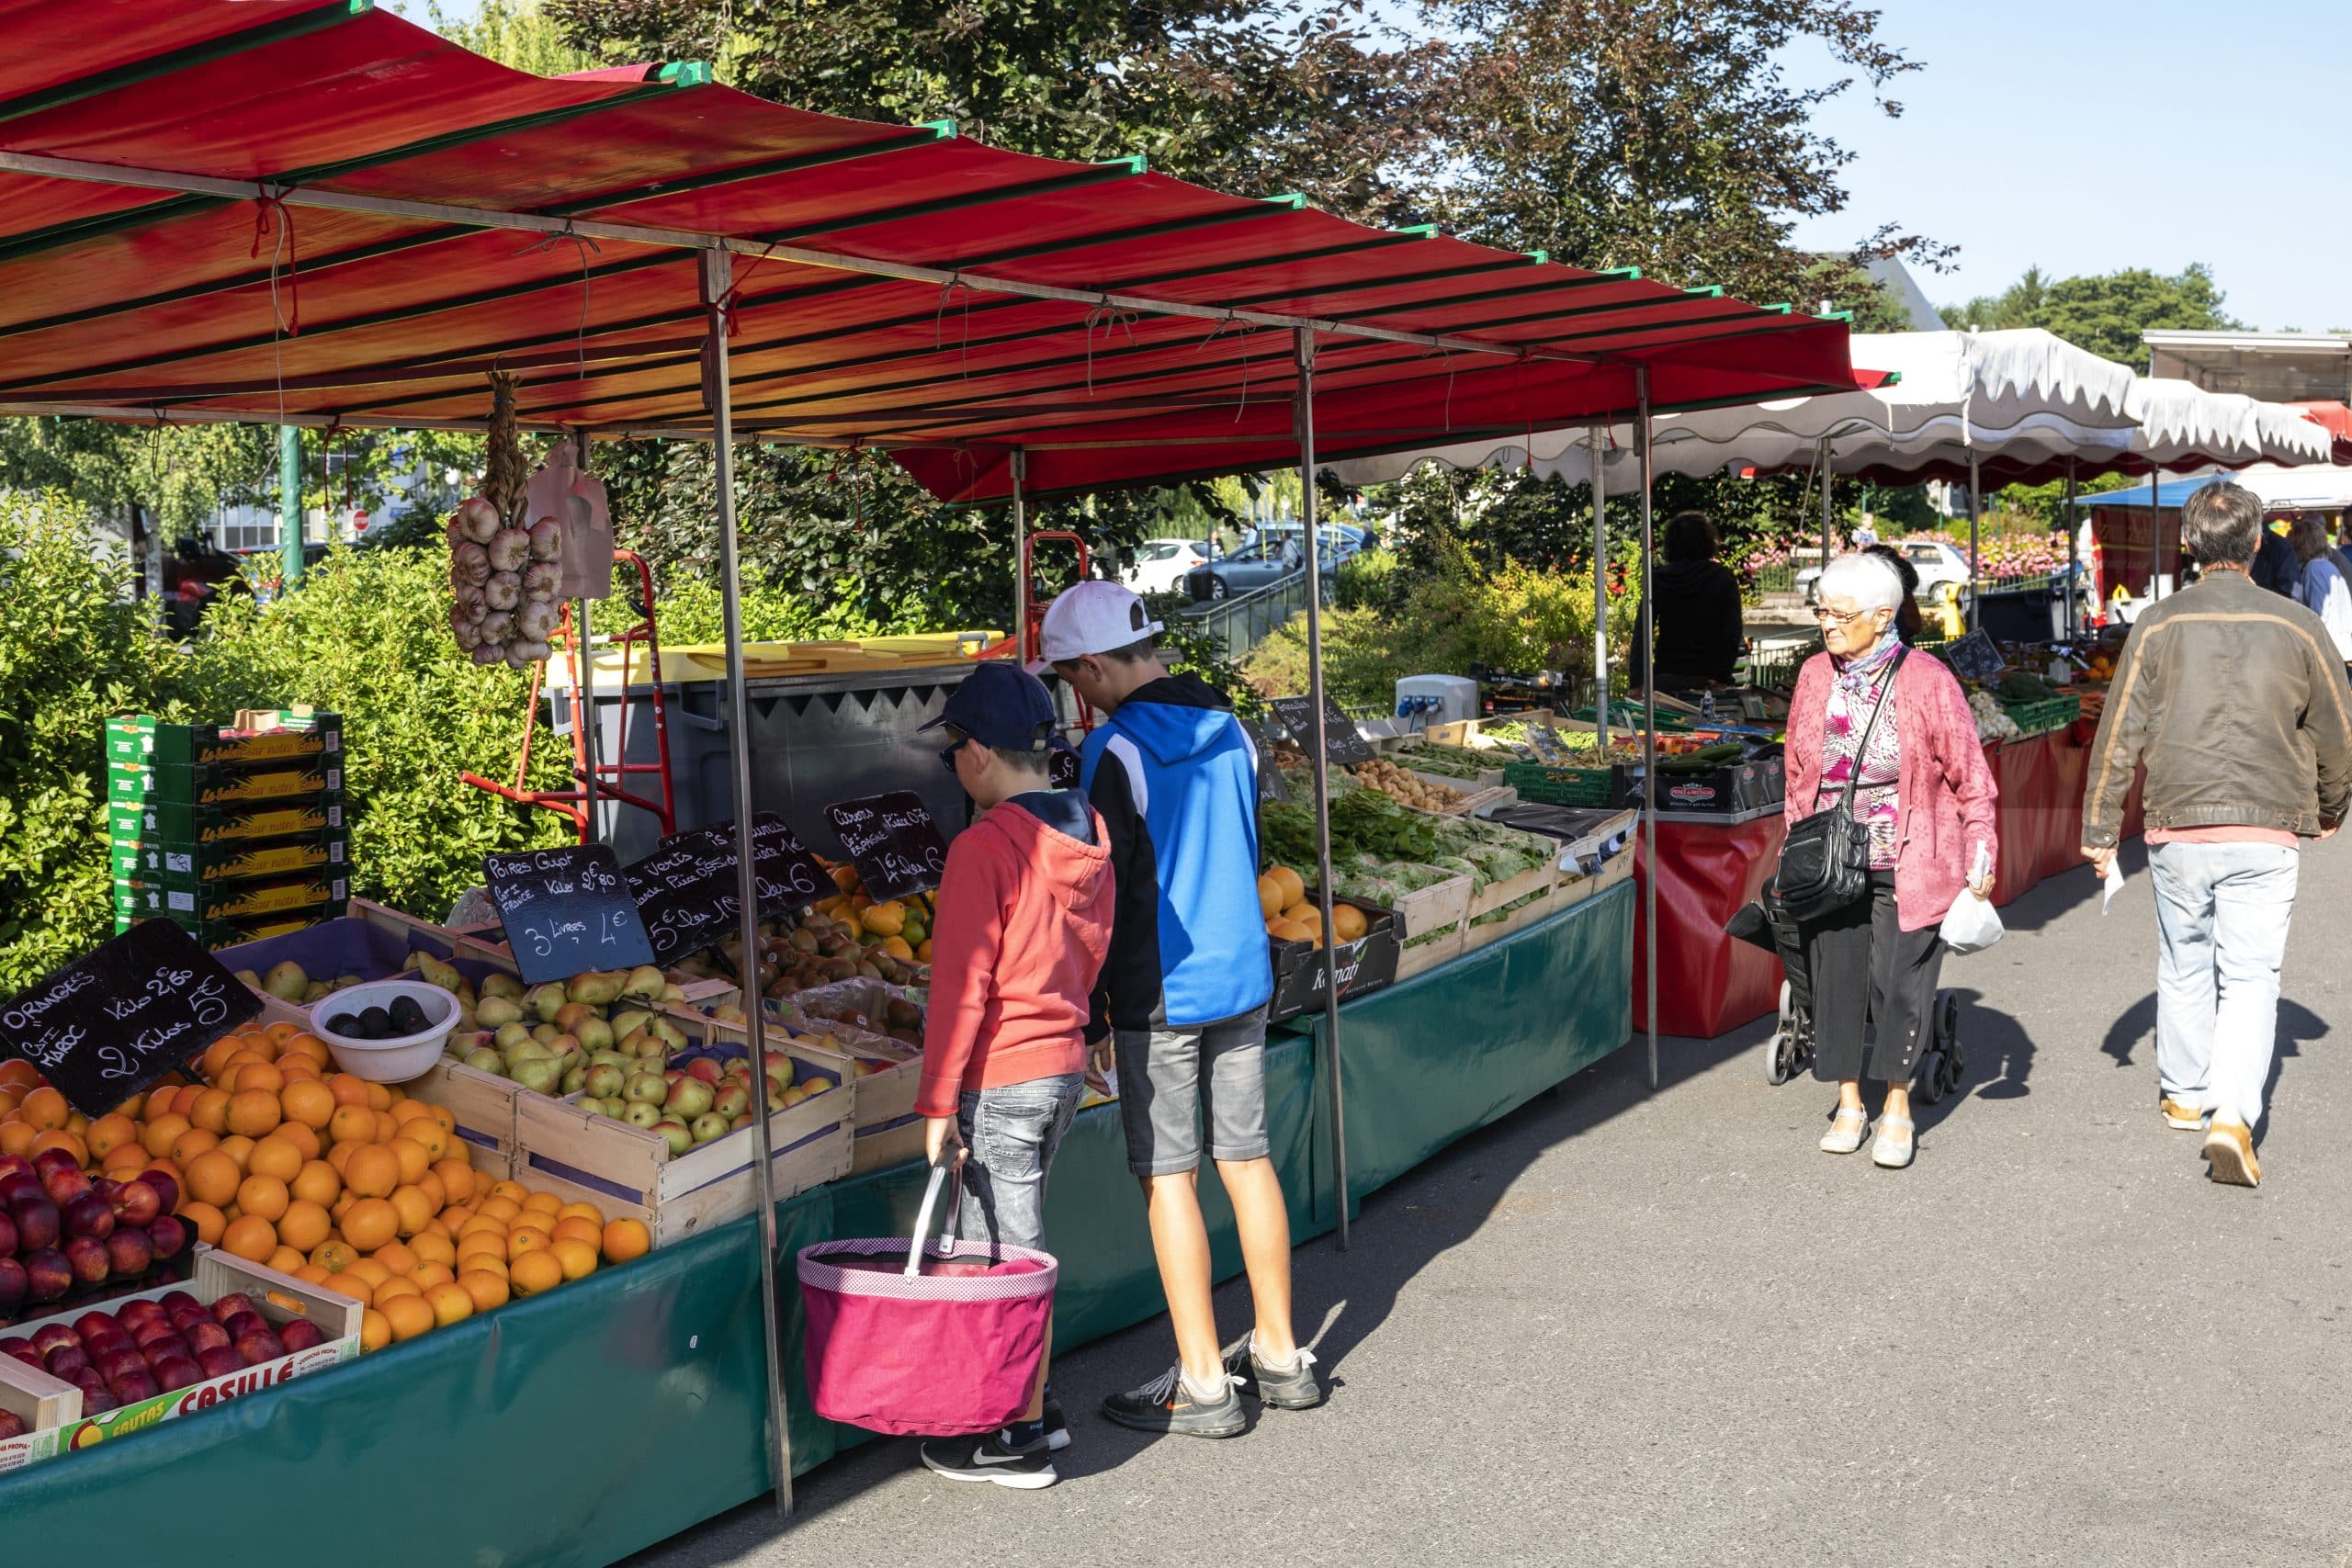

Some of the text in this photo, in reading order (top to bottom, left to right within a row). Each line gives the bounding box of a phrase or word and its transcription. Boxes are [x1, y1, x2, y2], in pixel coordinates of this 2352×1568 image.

[790, 863, 815, 893] 6
[525, 928, 552, 956] 3
[3, 970, 96, 1029] ORANGES
[40, 1023, 86, 1067] MAROC
[97, 1046, 140, 1078] 2
